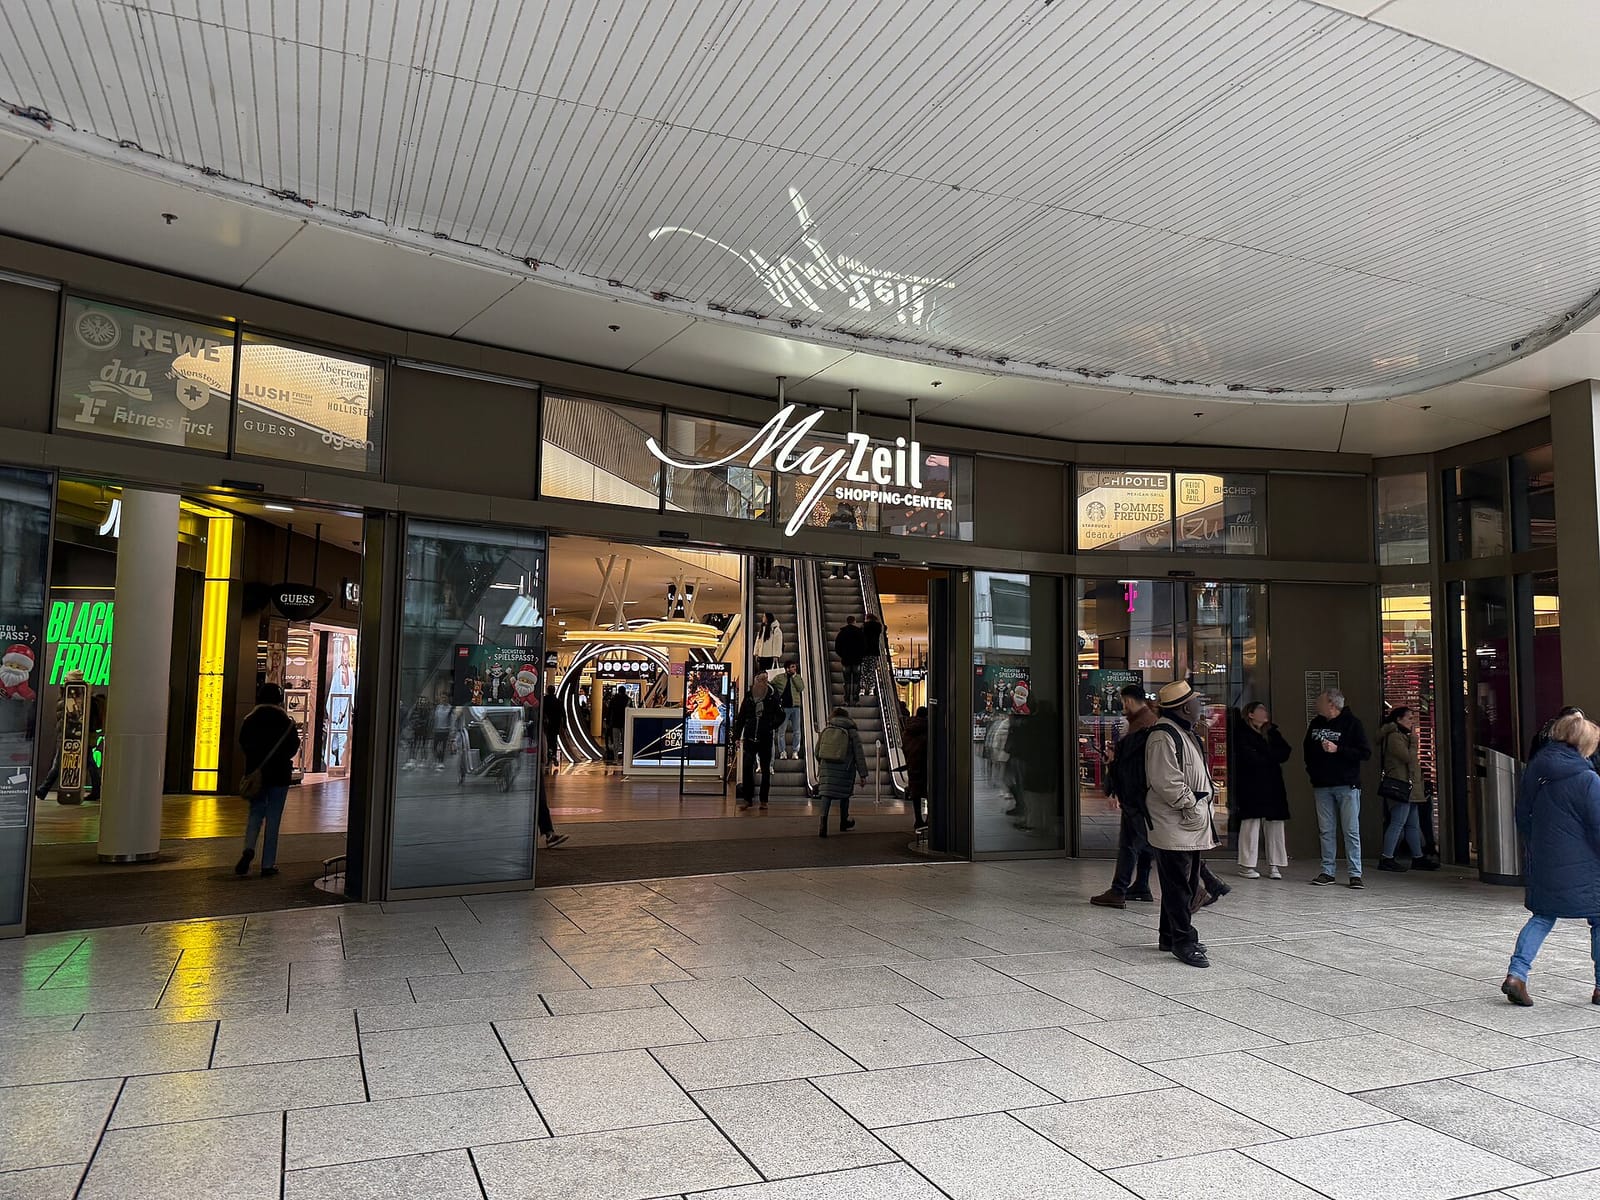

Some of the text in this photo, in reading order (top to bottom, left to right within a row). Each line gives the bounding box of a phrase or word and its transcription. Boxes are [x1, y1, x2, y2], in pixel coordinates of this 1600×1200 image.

[131, 324, 221, 363] REWE
[100, 359, 147, 387] dm
[340, 377, 365, 391] Fitch
[244, 383, 290, 402] LUSH
[327, 402, 375, 418] HOLLISTER
[178, 416, 214, 436] First
[243, 420, 296, 438] GUESS
[321, 431, 375, 451] dyson
[1102, 476, 1165, 487] CHIPOTLE
[1213, 486, 1257, 495] BIGCHEFS
[834, 486, 953, 511] SHOPPING-CENTER
[1113, 502, 1164, 512] POMMES
[1113, 512, 1165, 522] FREUNDE
[1085, 531, 1108, 539] dean
[280, 593, 315, 604] GUESS
[46, 601, 115, 644] BLACK
[705, 663, 725, 671] NEWS
[1138, 659, 1171, 669] BLACK
